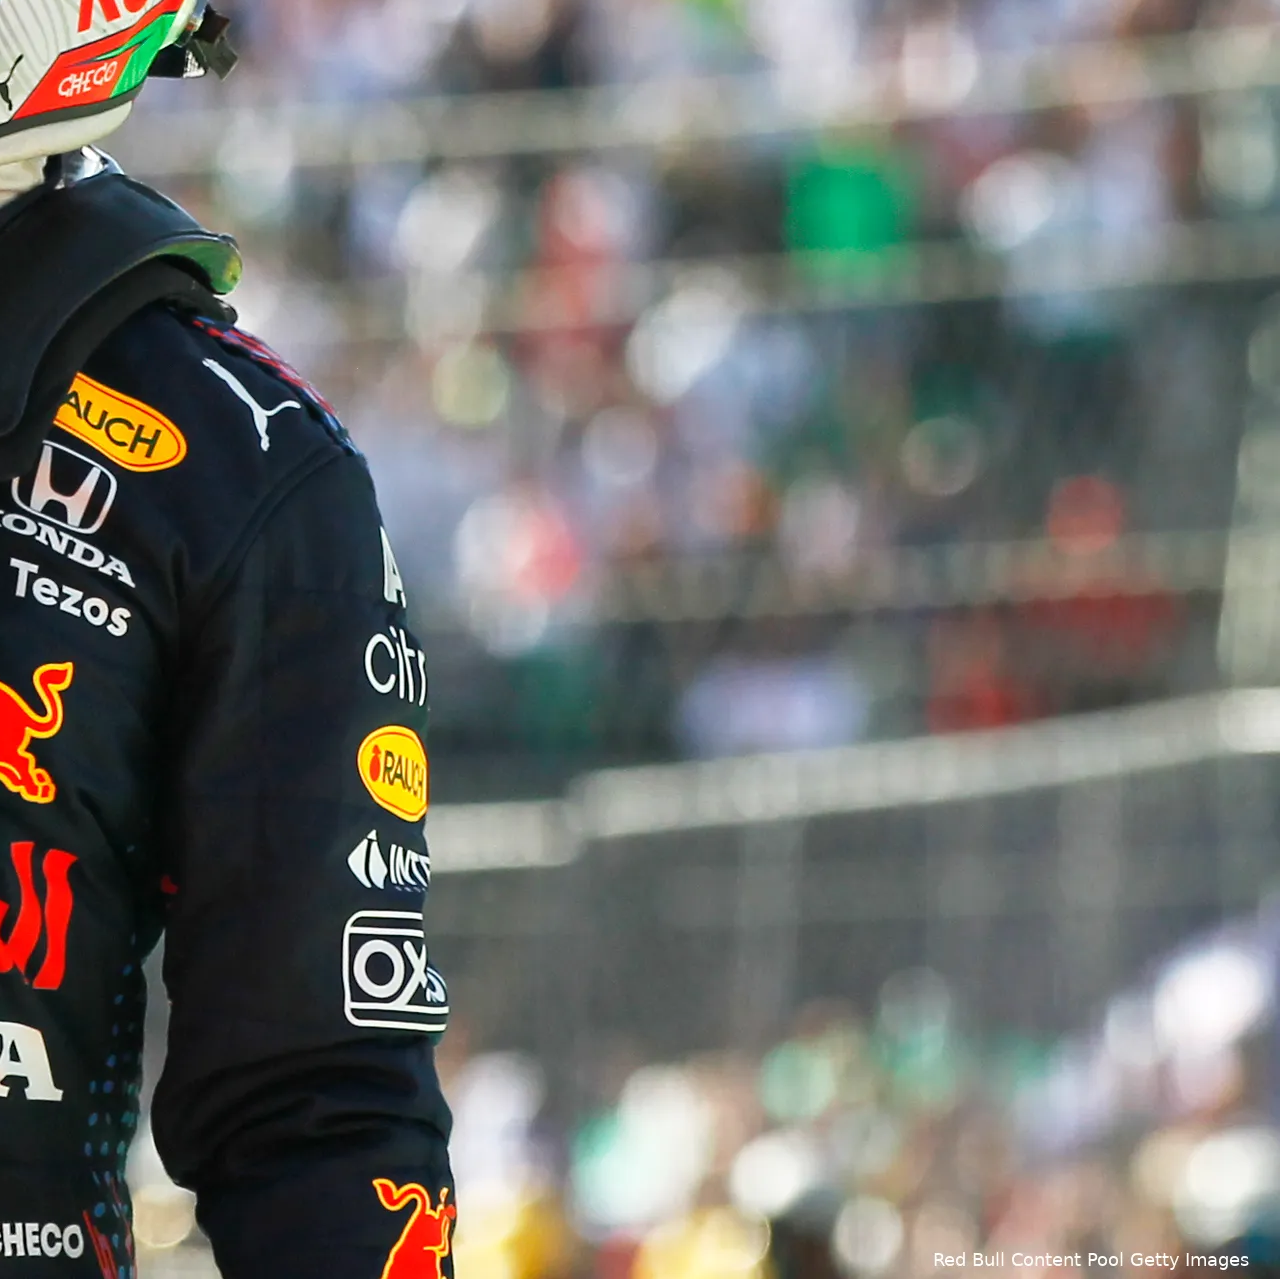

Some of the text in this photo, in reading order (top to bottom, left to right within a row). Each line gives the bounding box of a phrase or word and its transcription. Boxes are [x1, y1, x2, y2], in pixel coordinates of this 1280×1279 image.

[57, 60, 118, 98] CHECO
[66, 390, 162, 459] AUCH
[9, 557, 132, 638] Tezos
[382, 750, 424, 800] RAUCH
